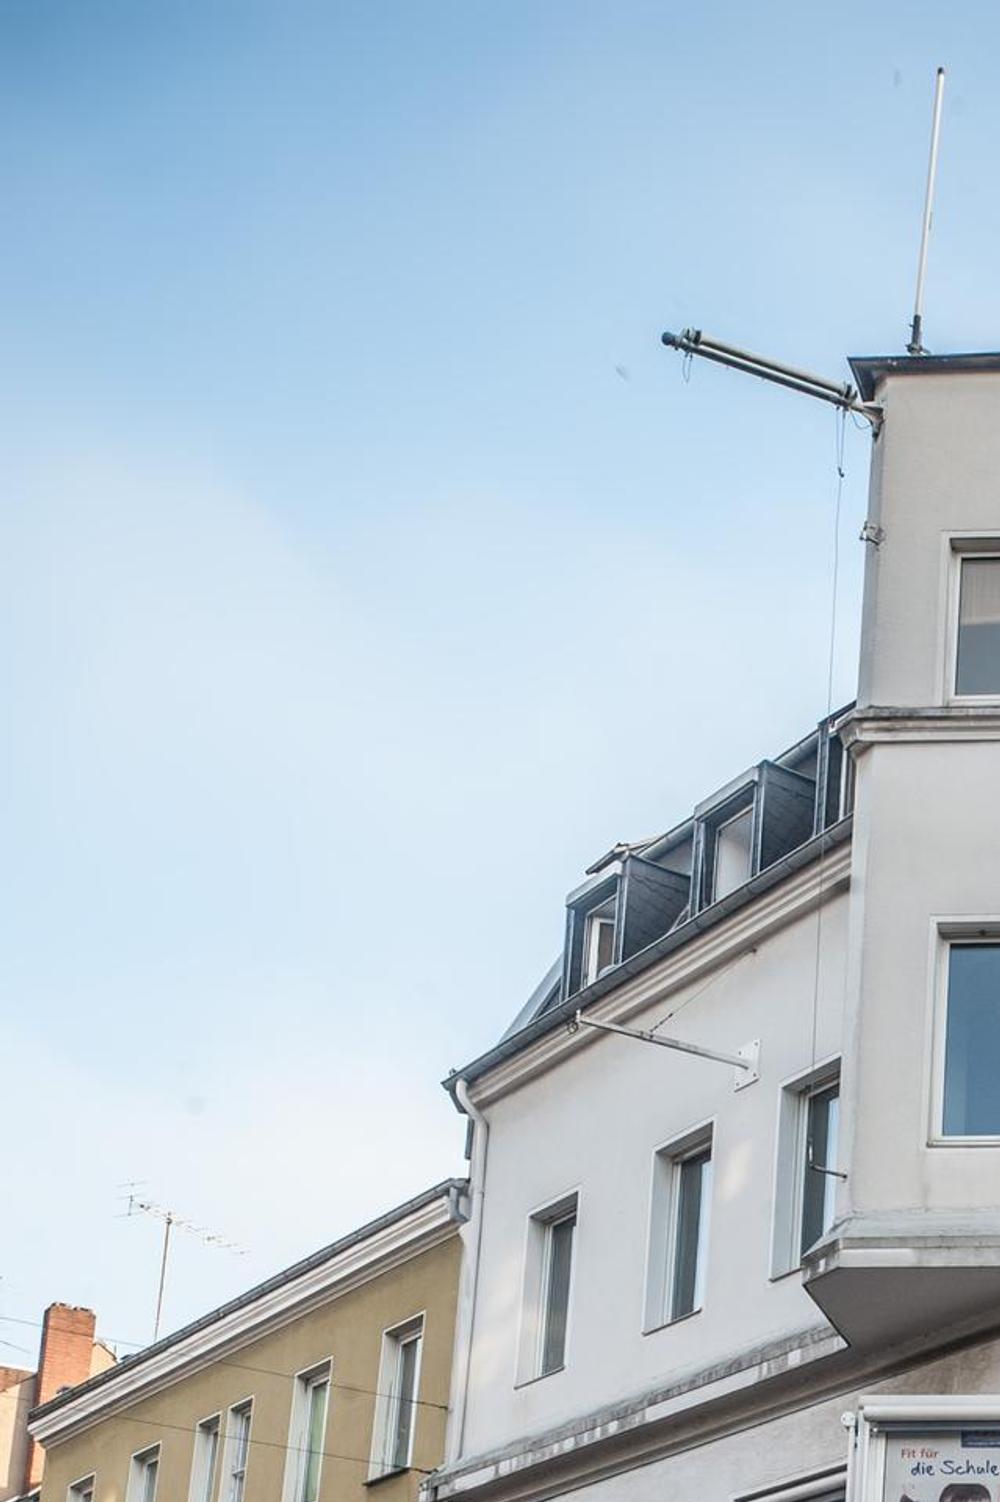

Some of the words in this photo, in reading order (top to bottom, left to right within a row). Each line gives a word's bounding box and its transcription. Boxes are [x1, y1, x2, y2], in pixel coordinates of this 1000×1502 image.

[901, 1449, 916, 1458] Fit
[920, 1448, 939, 1458] für
[910, 1461, 935, 1475] die
[940, 1460, 1000, 1476] Schule
